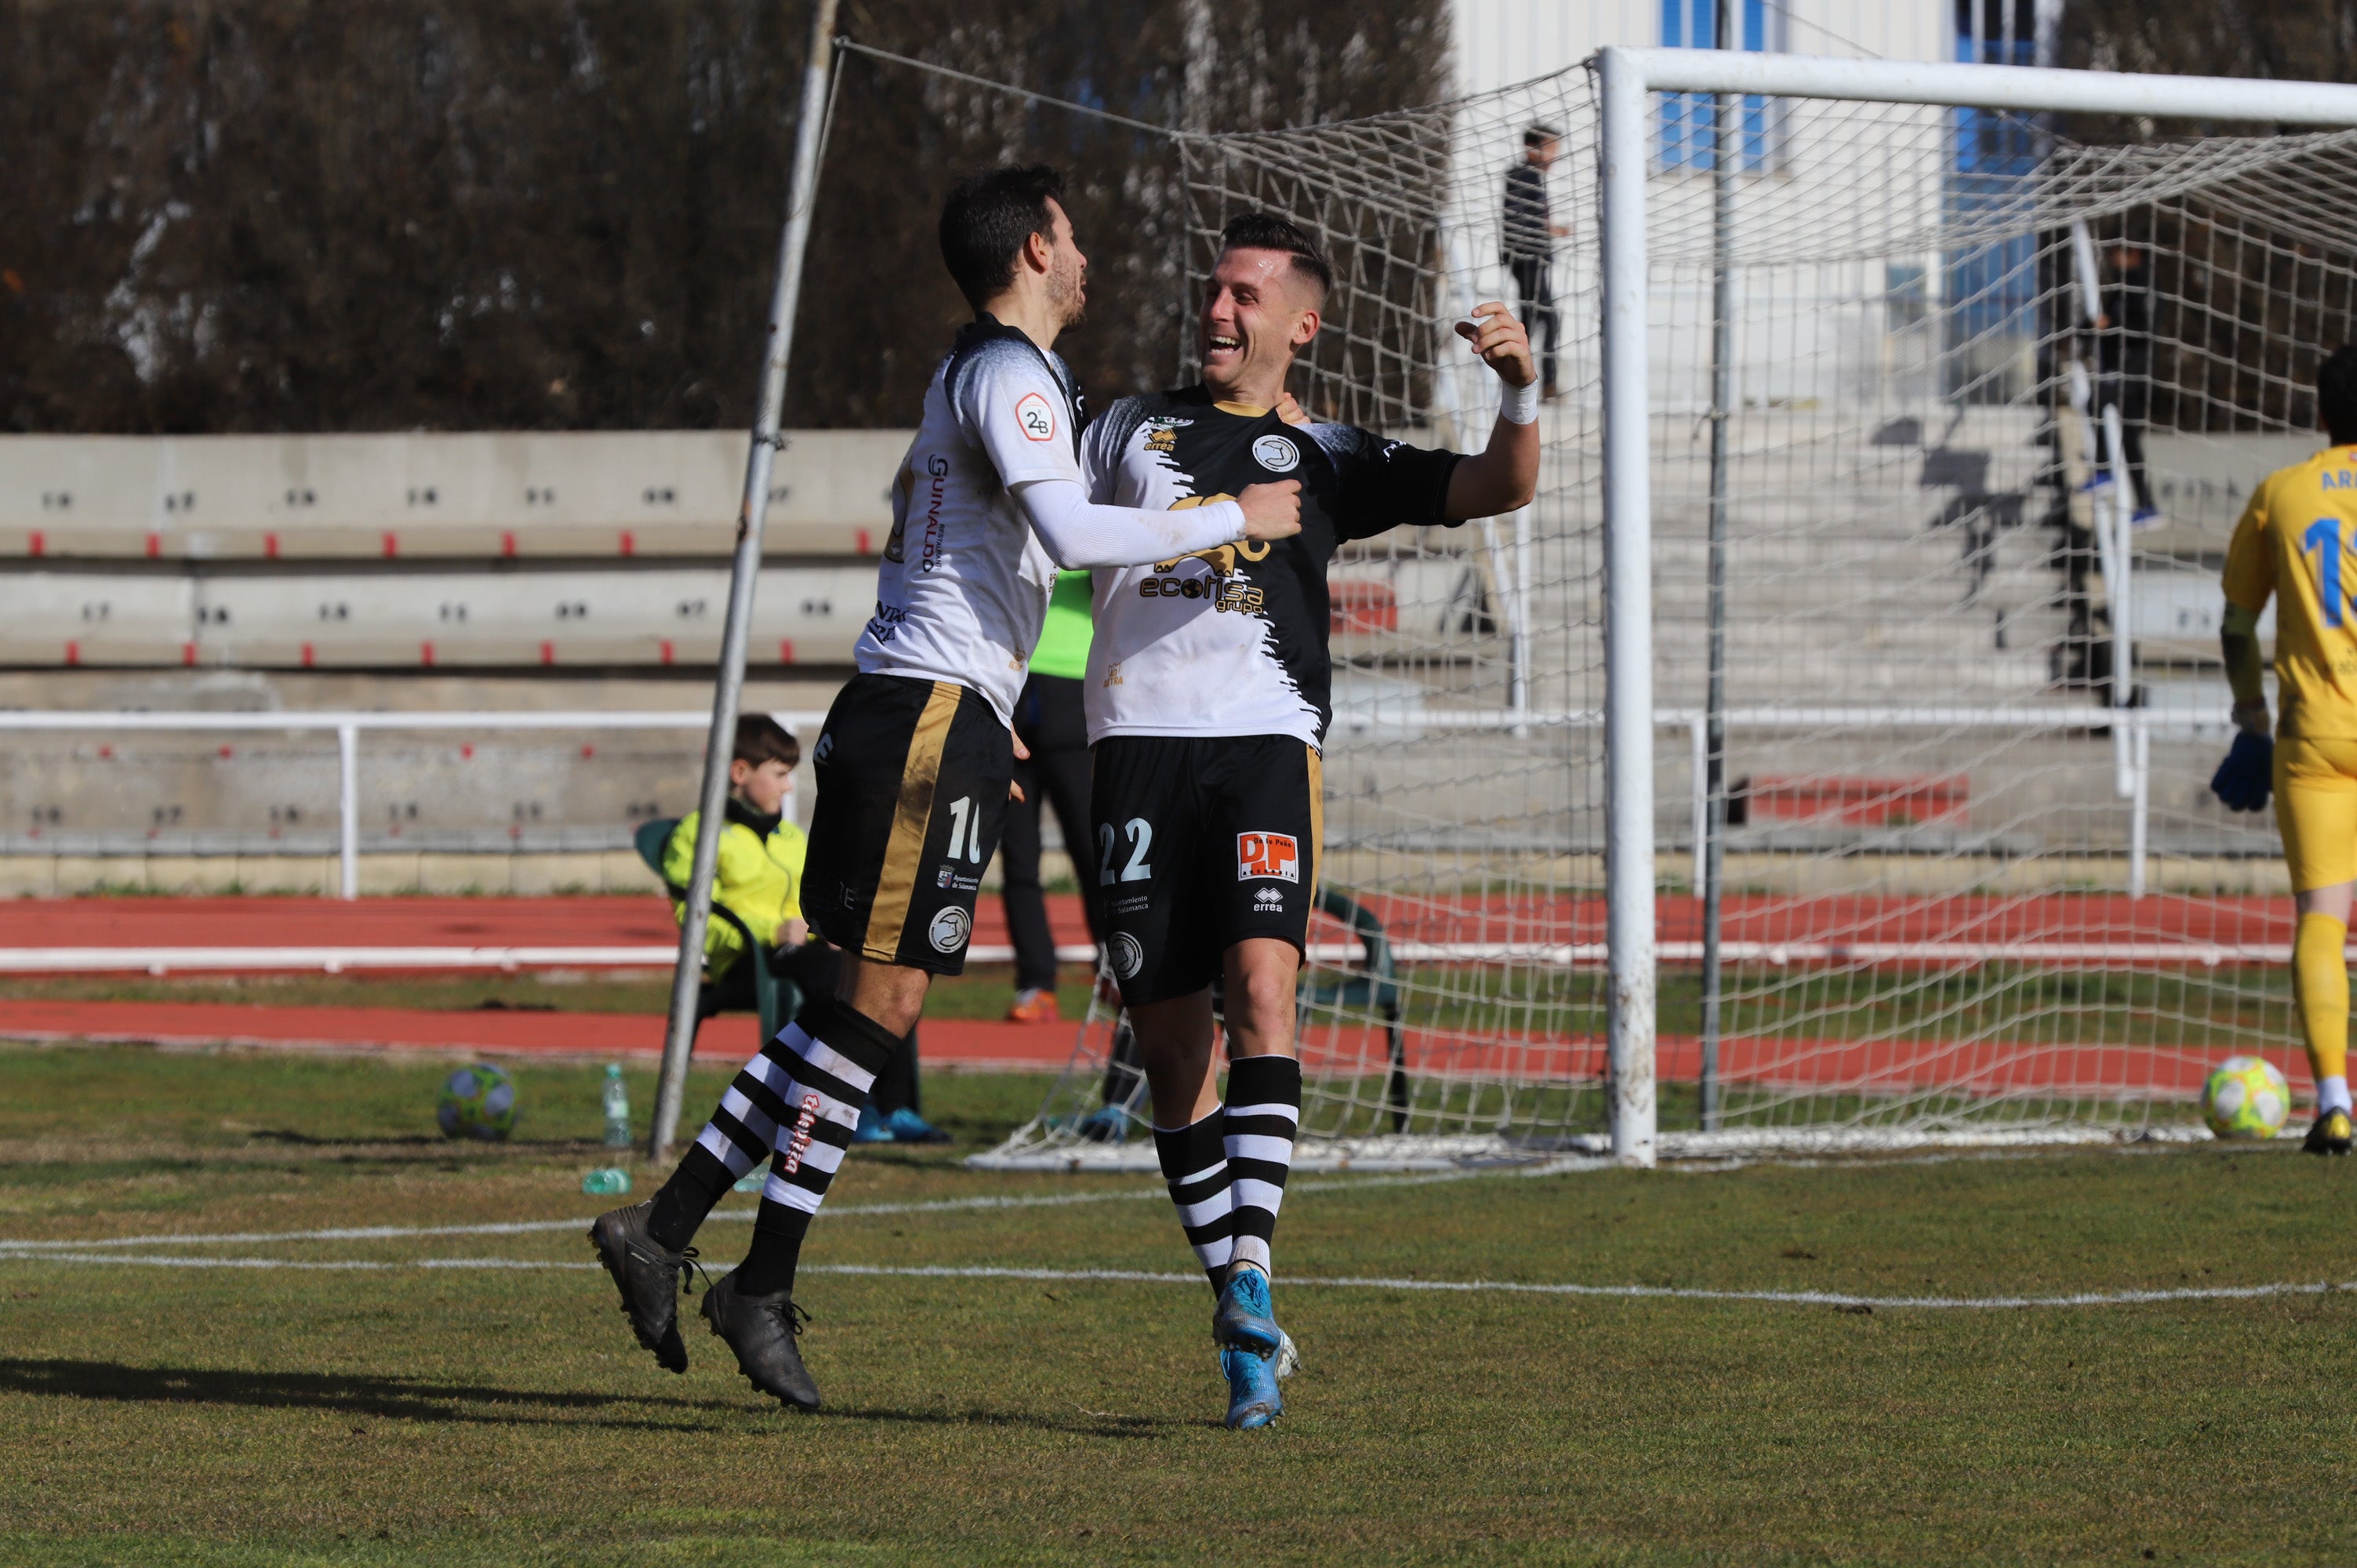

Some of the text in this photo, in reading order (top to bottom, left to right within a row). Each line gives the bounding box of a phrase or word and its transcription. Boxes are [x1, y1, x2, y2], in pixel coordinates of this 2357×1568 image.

[2322, 468, 2357, 492] AR
[922, 453, 949, 573] GUINALDO
[2297, 517, 2357, 630] 1
[1215, 599, 1264, 615] grupo
[1099, 817, 1152, 887] 22
[1118, 902, 1149, 914] Salamanca
[1253, 903, 1283, 913] errea
[784, 1094, 819, 1175] telepizza
